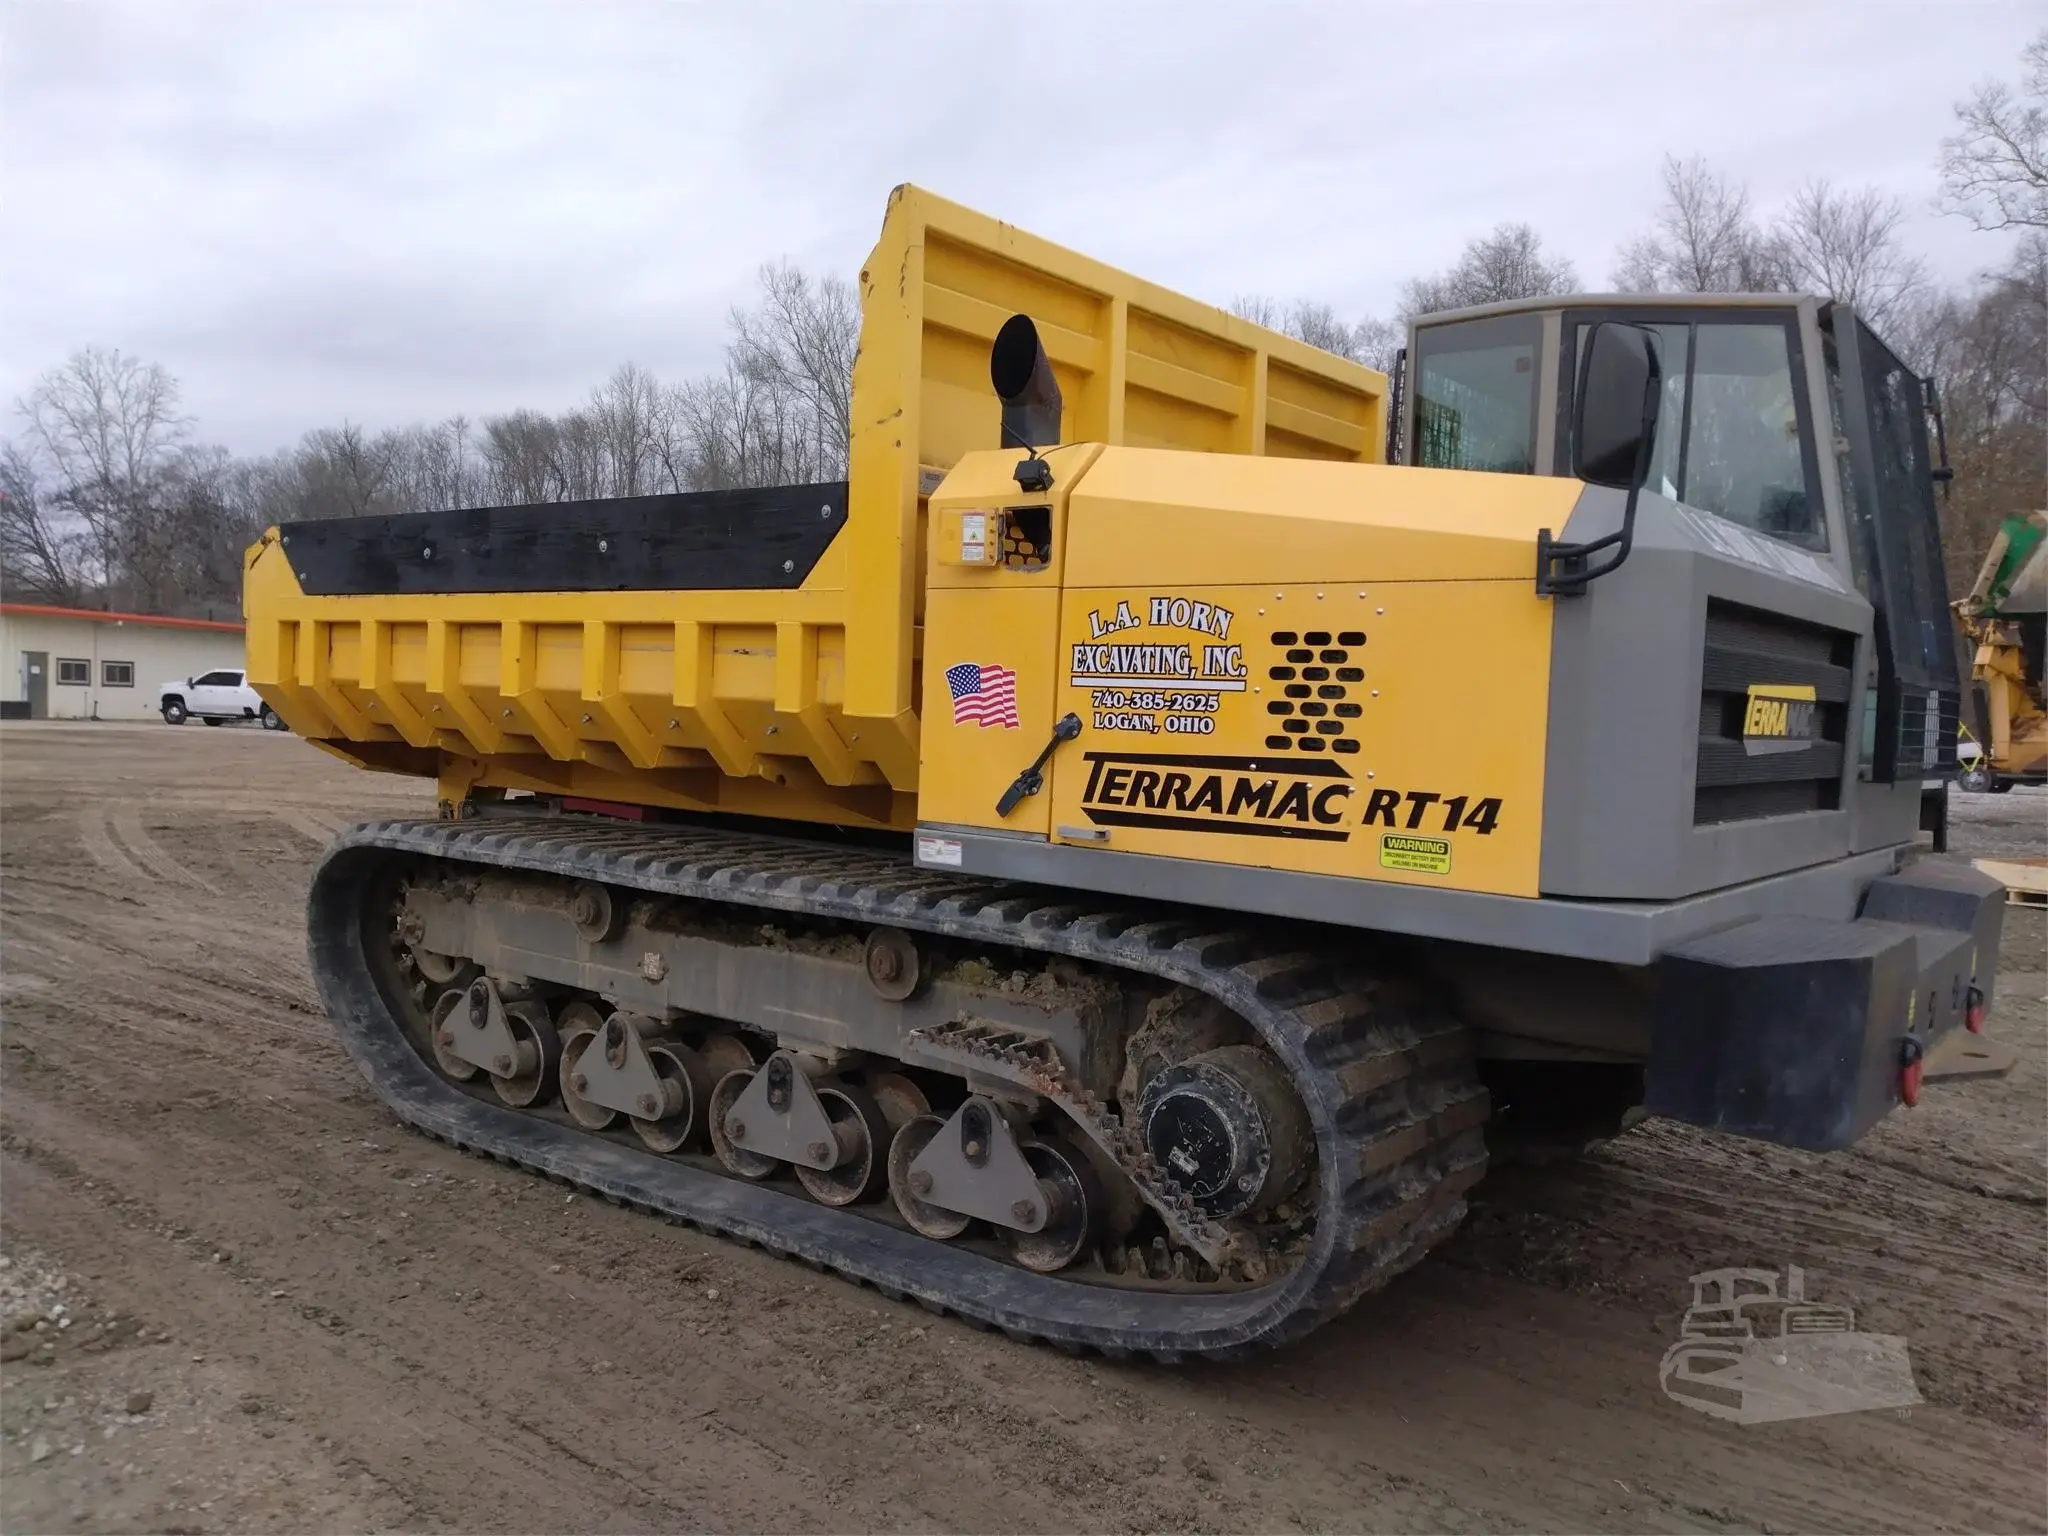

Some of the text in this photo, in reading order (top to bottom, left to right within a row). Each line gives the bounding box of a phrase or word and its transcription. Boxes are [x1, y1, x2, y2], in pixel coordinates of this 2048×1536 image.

[1088, 597, 1234, 640] L.A. HORN
[1071, 642, 1248, 680] EXCAVATING, INC.
[1091, 690, 1221, 713] 740-385-2625
[1093, 711, 1216, 734] LOGAN, OHIO
[1081, 751, 1503, 836] TERRAMAC RT14
[1387, 837, 1445, 854] WARNING
